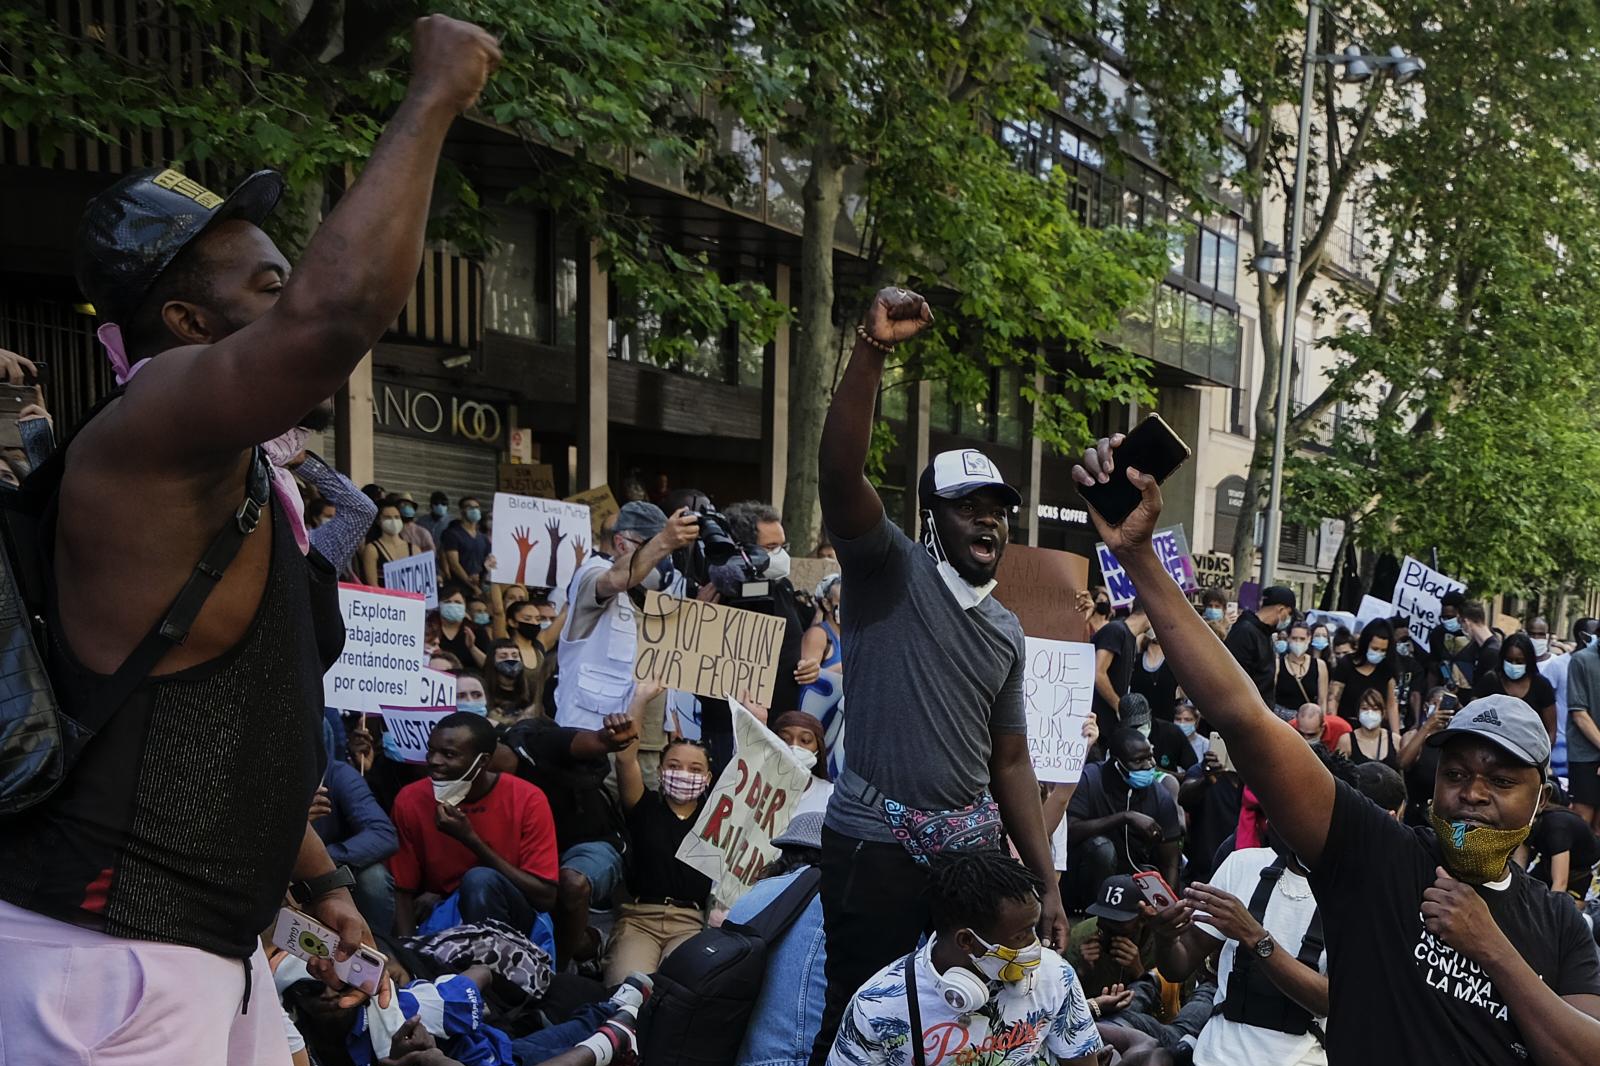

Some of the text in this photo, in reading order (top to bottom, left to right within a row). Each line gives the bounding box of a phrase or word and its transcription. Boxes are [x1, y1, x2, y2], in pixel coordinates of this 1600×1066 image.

[508, 497, 540, 512] Black
[1060, 507, 1088, 524] COFFEE
[1192, 554, 1230, 573] VIDAS
[1195, 571, 1234, 590] NEGRAS
[1404, 561, 1460, 600] Black
[348, 600, 407, 622] ¡Explotan
[1397, 587, 1436, 624] Live
[642, 593, 718, 653] STOP
[635, 647, 768, 705] OUR PEOPLE
[1032, 649, 1081, 685] QUE
[333, 675, 408, 696] por colores!
[1053, 684, 1090, 718] DE
[1039, 717, 1063, 740] UN
[1472, 714, 1503, 727] adidas
[1105, 886, 1125, 906] 13
[1425, 968, 1449, 993] LA
